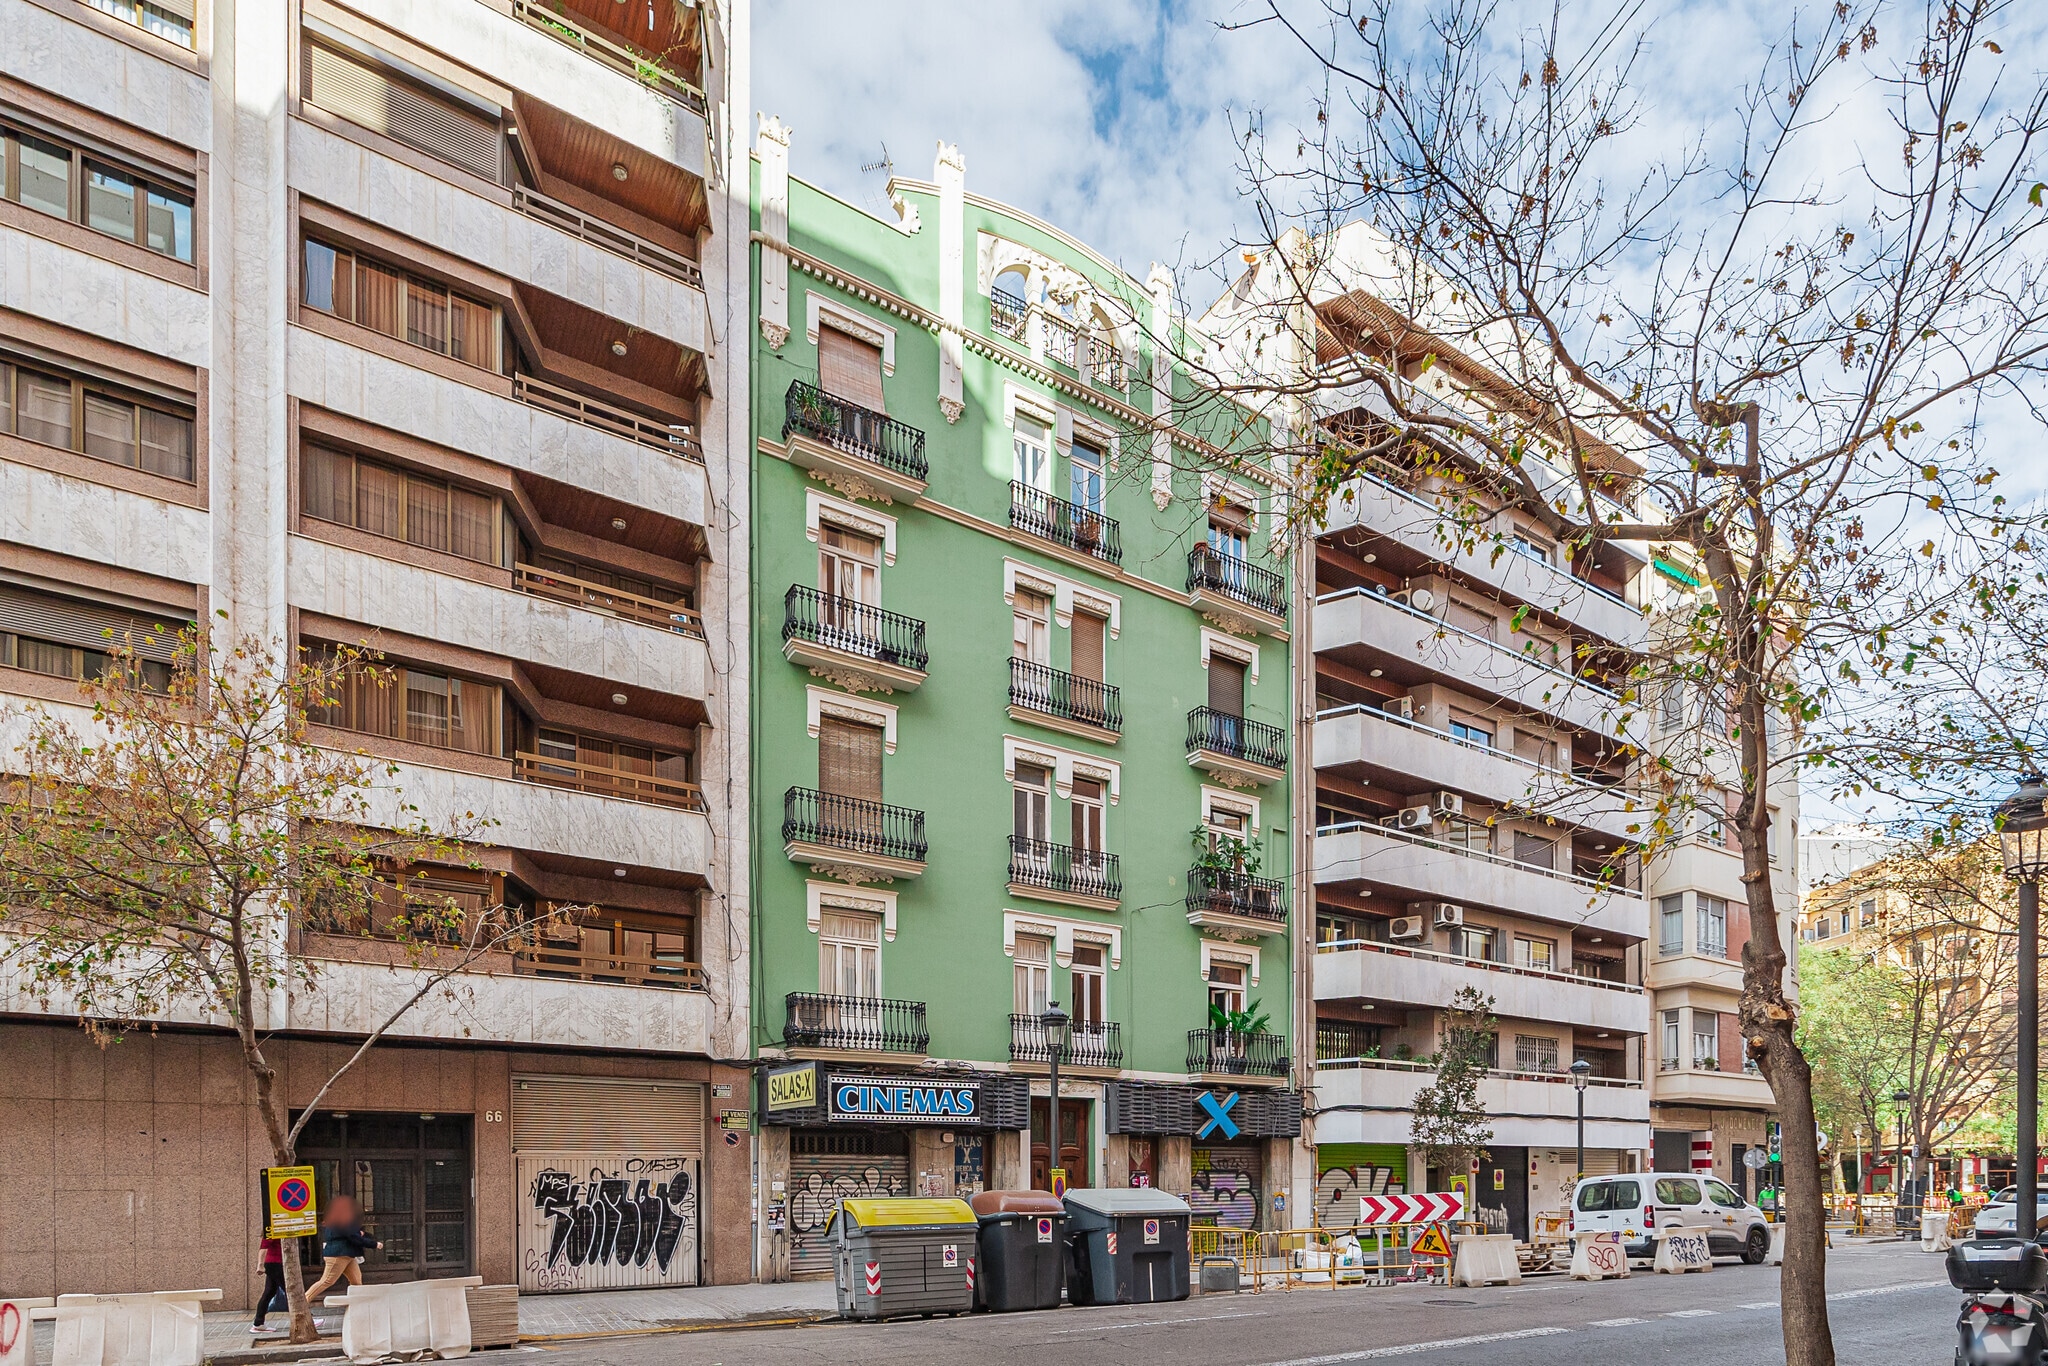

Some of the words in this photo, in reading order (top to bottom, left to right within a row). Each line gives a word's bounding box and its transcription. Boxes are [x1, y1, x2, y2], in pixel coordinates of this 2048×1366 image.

[771, 1072, 812, 1102] SALAS-X
[836, 1085, 975, 1115] CINEMAS
[485, 1110, 503, 1123] 66
[1195, 1091, 1240, 1140] X
